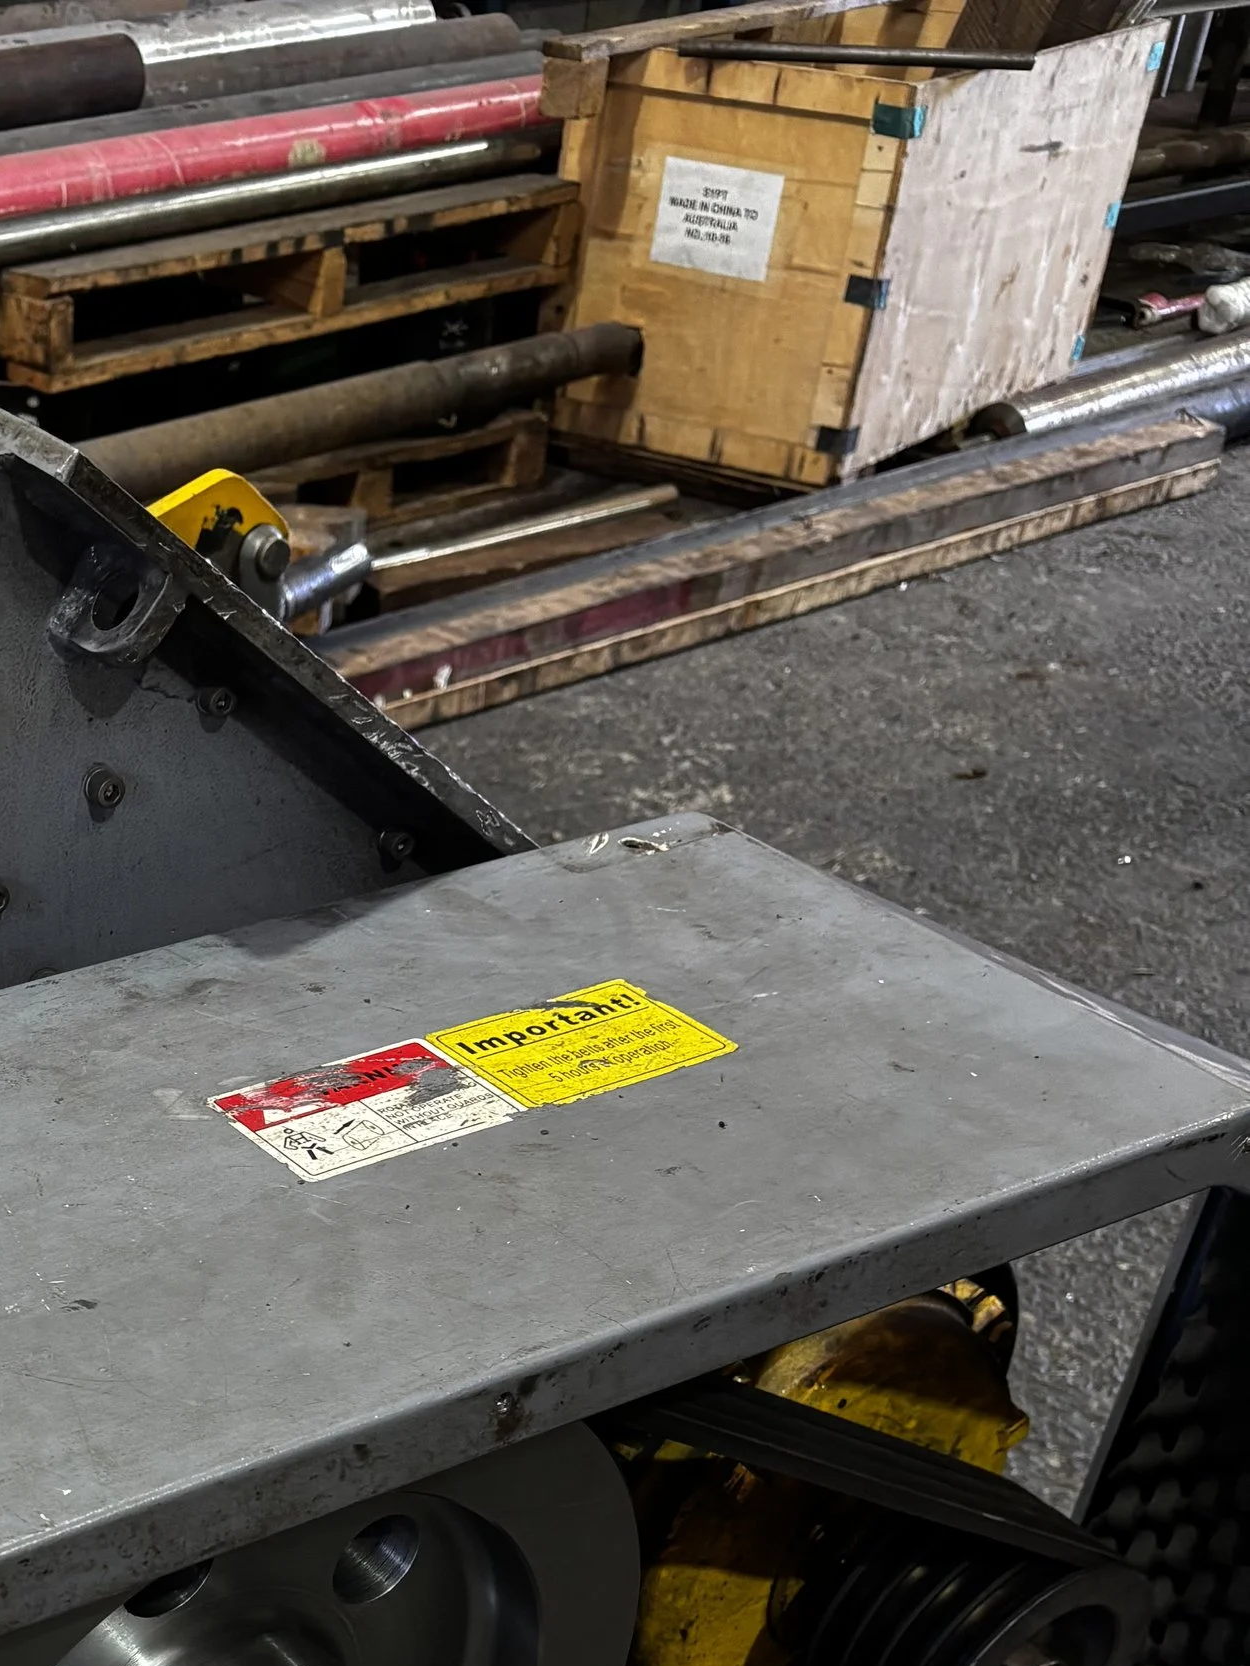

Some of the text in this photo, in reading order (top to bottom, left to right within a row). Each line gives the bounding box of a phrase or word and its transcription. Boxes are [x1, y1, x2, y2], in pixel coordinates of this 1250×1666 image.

[669, 196, 758, 220] MADE IN CHINA TO
[682, 213, 738, 232] AUSTRALIA
[457, 993, 641, 1055] Important!
[497, 1018, 681, 1079] Tighten the belts after the first
[548, 1072, 563, 1083] 5
[559, 1062, 601, 1080] hours
[385, 1093, 463, 1120] NOT OPERATE
[393, 1092, 494, 1125] WITHOUT GUARDS
